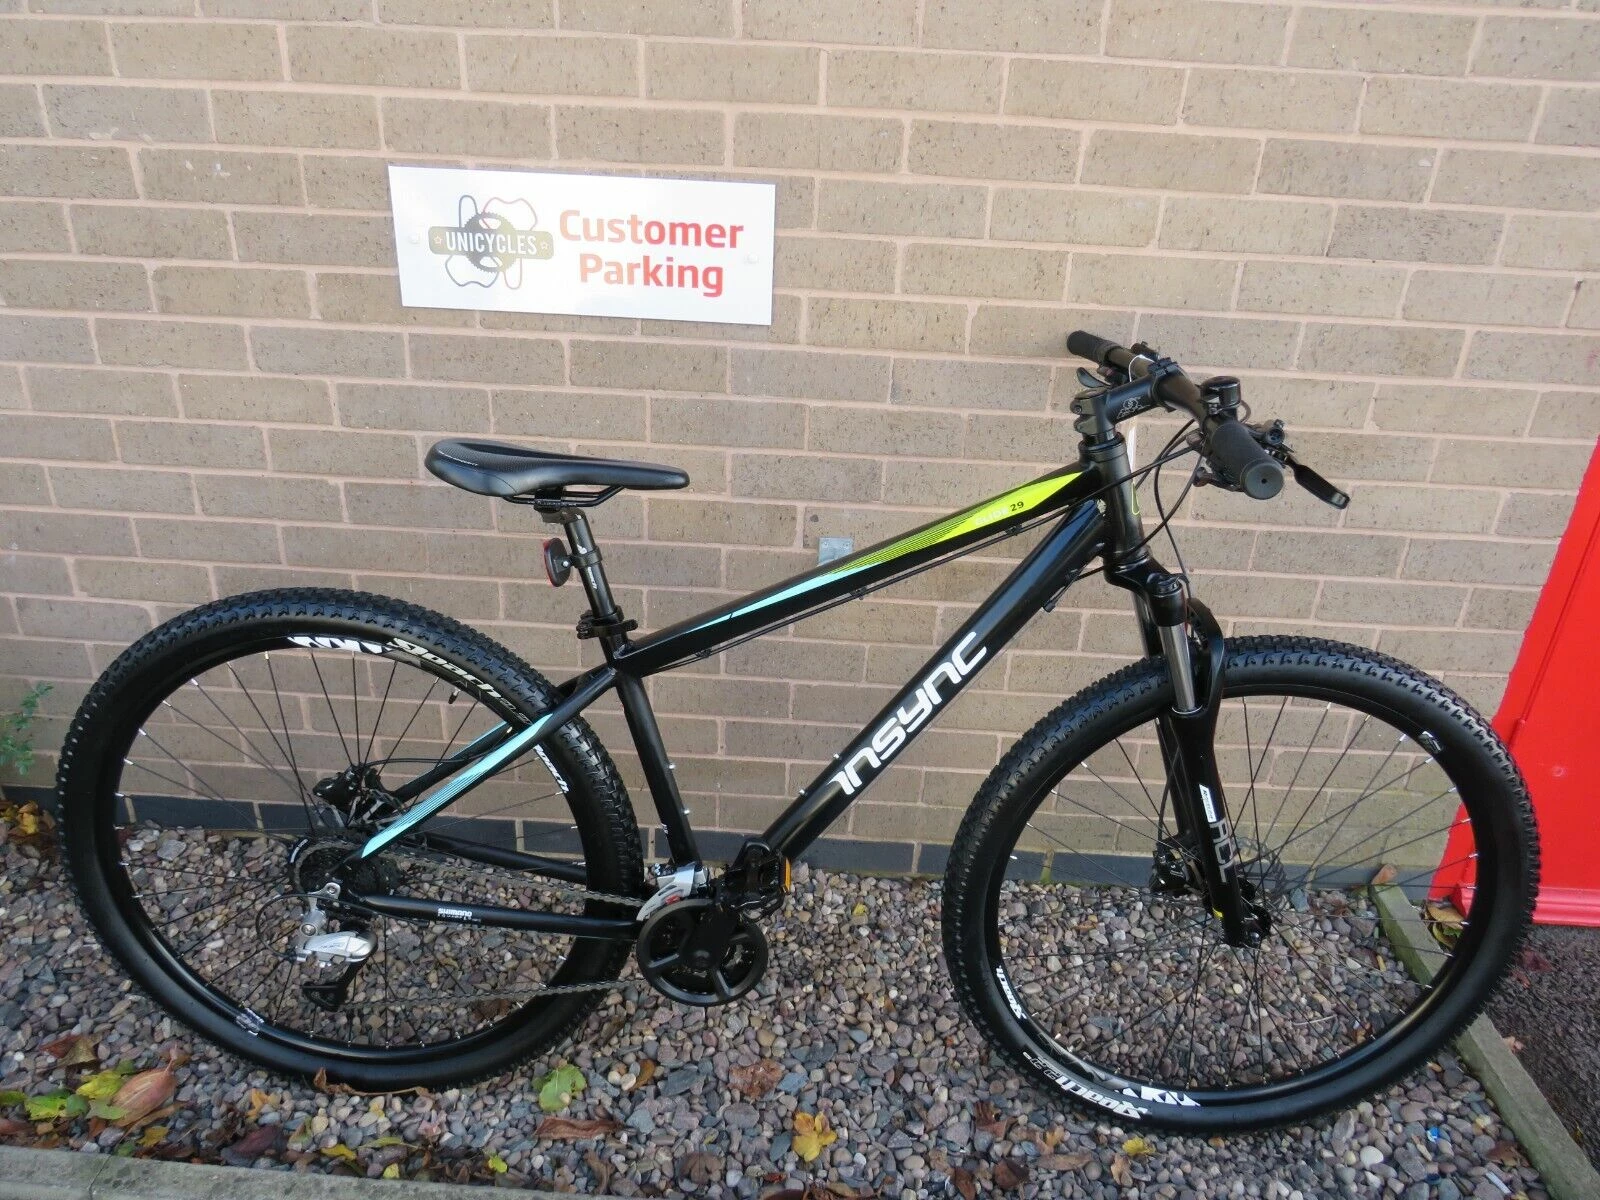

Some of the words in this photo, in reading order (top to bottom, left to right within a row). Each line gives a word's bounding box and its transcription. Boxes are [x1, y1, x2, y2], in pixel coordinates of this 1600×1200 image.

[445, 231, 537, 255] UNICYCLES
[559, 209, 744, 249] Customer
[579, 253, 724, 297] Parking
[1010, 501, 1025, 512] 29
